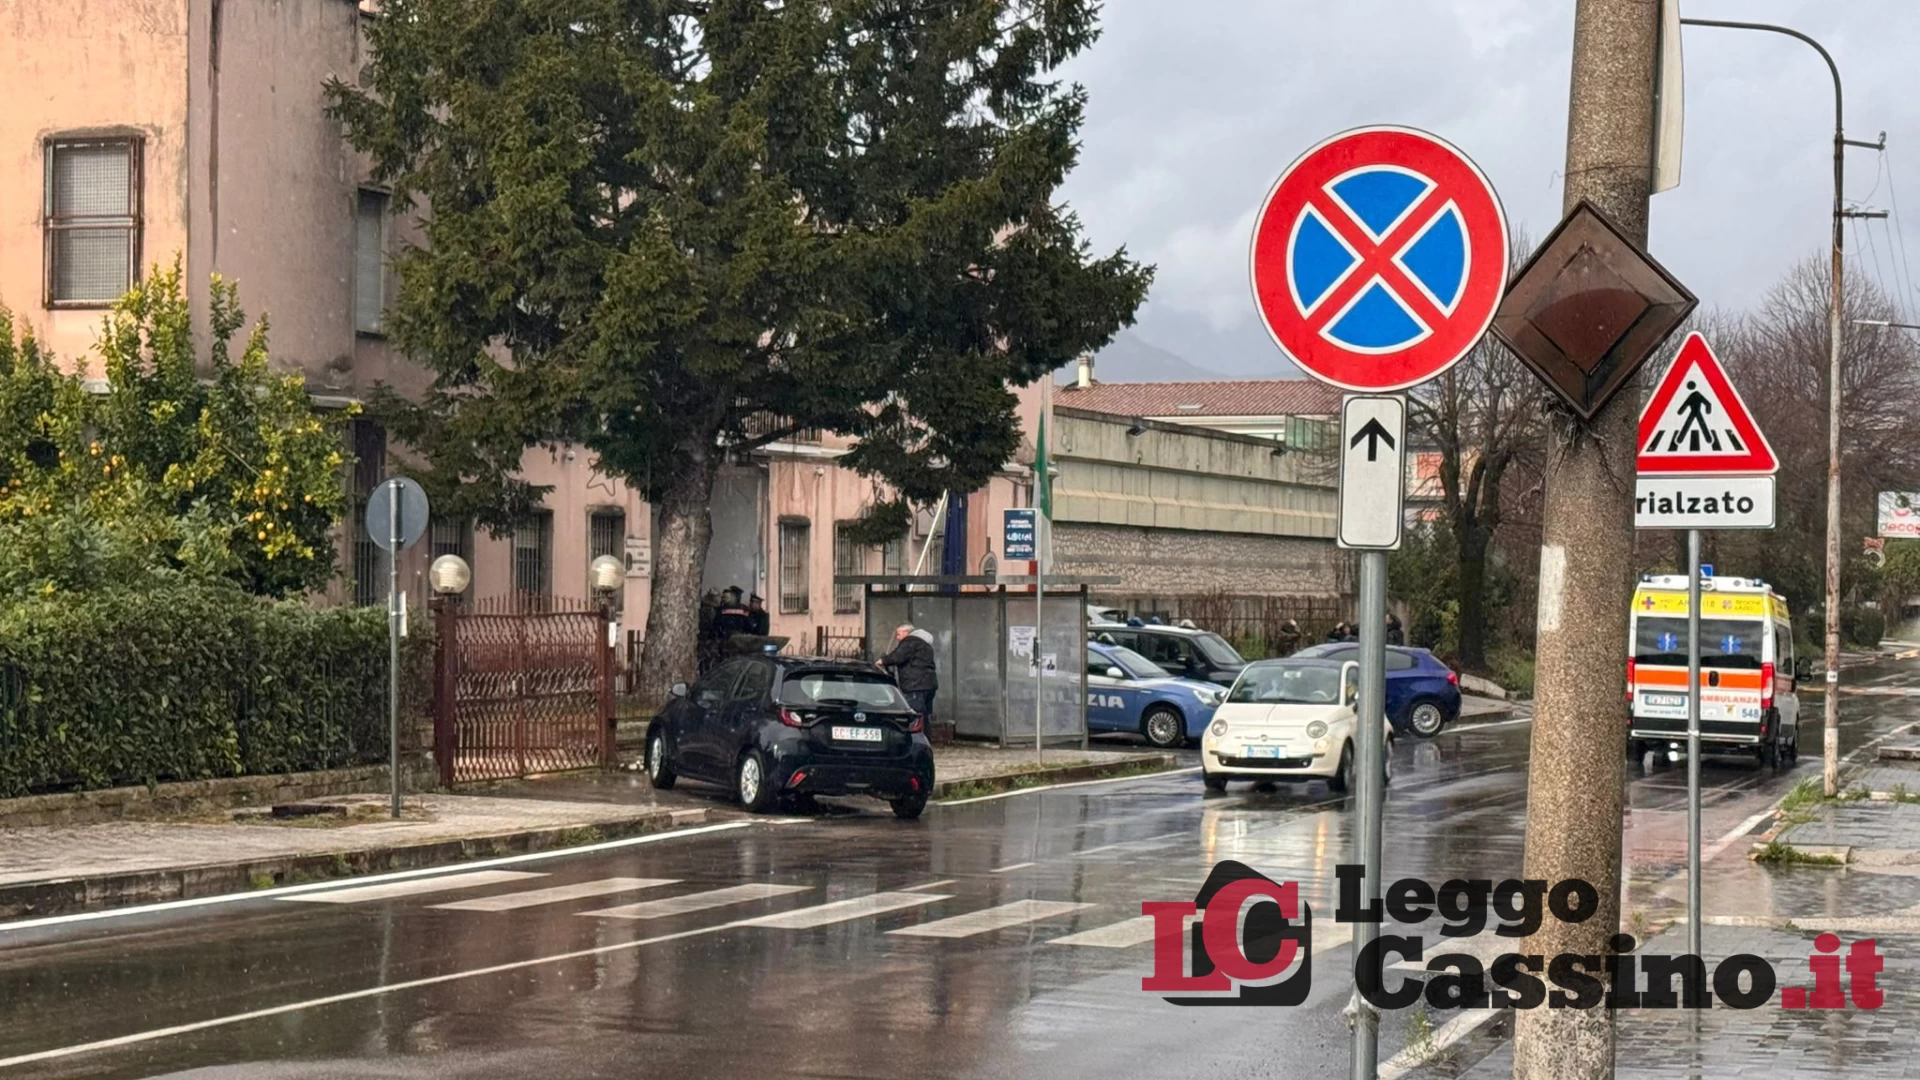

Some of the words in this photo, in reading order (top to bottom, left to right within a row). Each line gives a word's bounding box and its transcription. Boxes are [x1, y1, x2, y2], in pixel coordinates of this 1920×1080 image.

[1636, 491, 1754, 514] rialzato
[1700, 695, 1759, 704] AMBULANZA
[1741, 708, 1760, 719] 548
